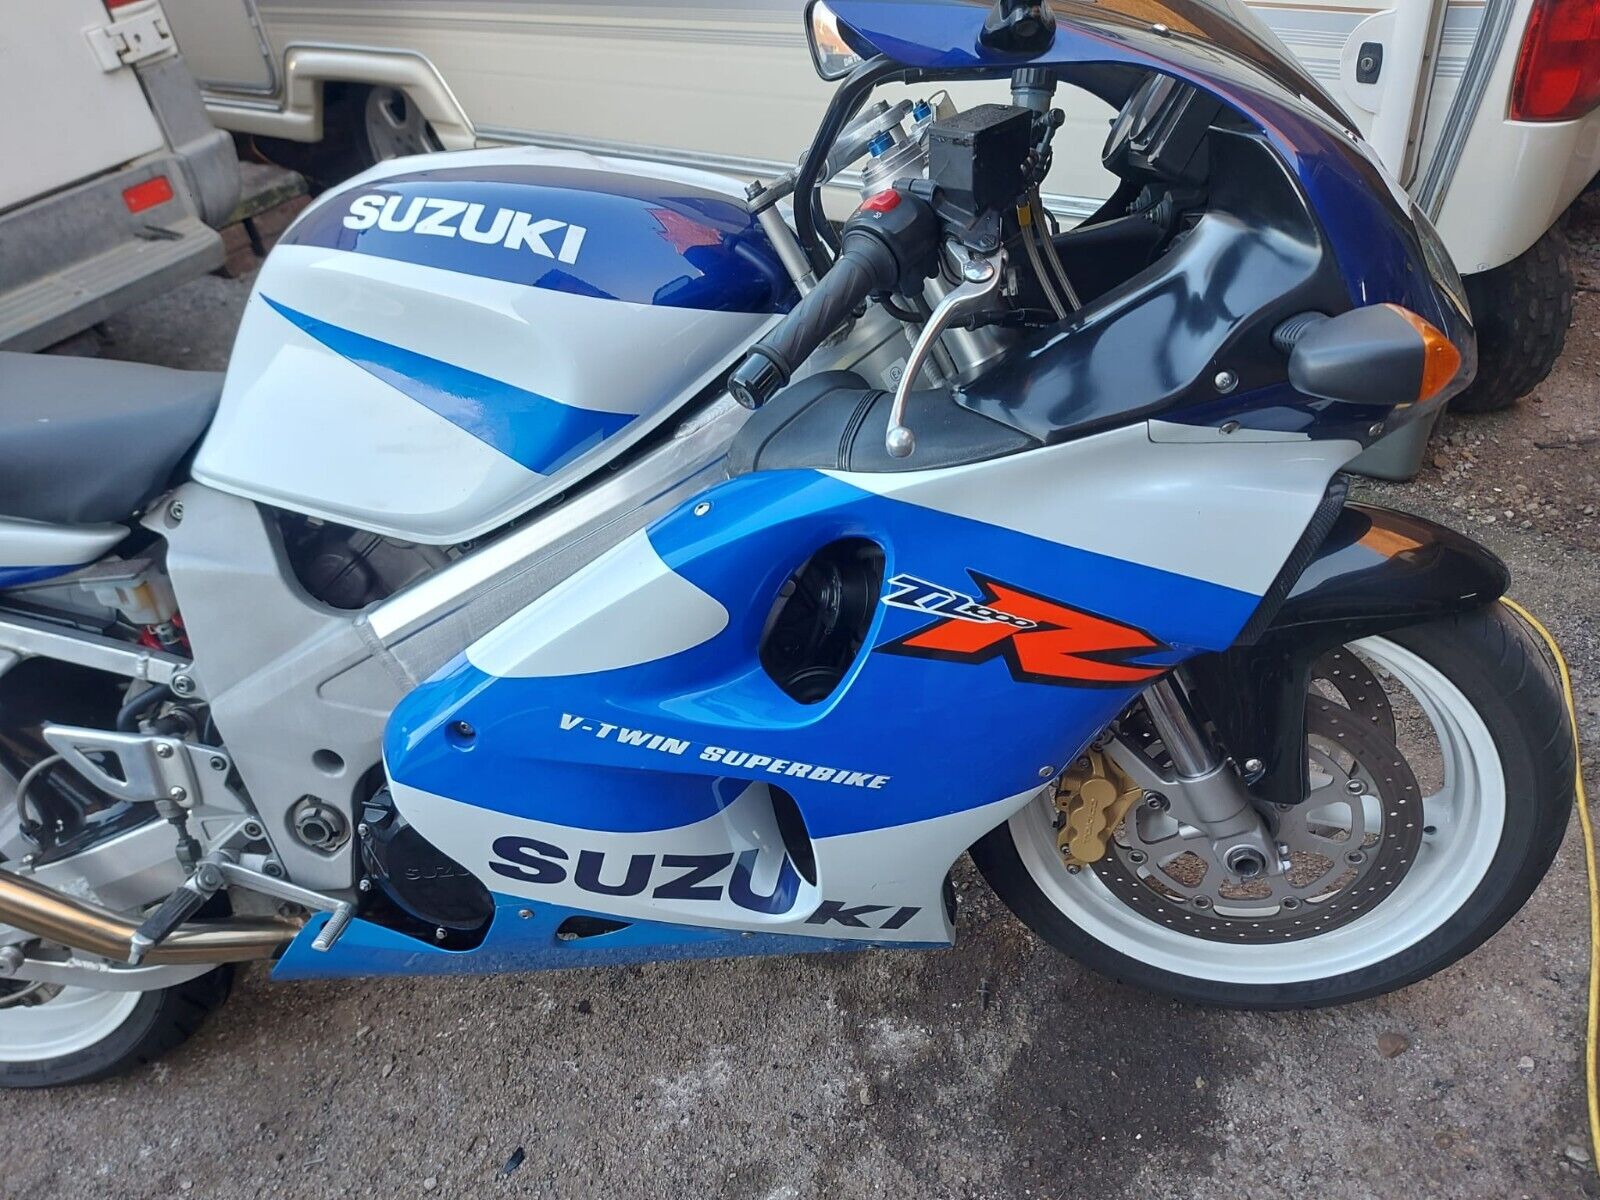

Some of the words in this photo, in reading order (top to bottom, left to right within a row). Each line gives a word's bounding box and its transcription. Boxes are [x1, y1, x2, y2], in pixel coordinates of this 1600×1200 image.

[343, 195, 587, 265] SUZUKI
[870, 567, 1171, 689] R
[559, 713, 690, 755] V-TWIN
[700, 746, 892, 789] SUPERBIKE
[405, 866, 470, 880] SUZU
[488, 835, 922, 930] SUZUKI
